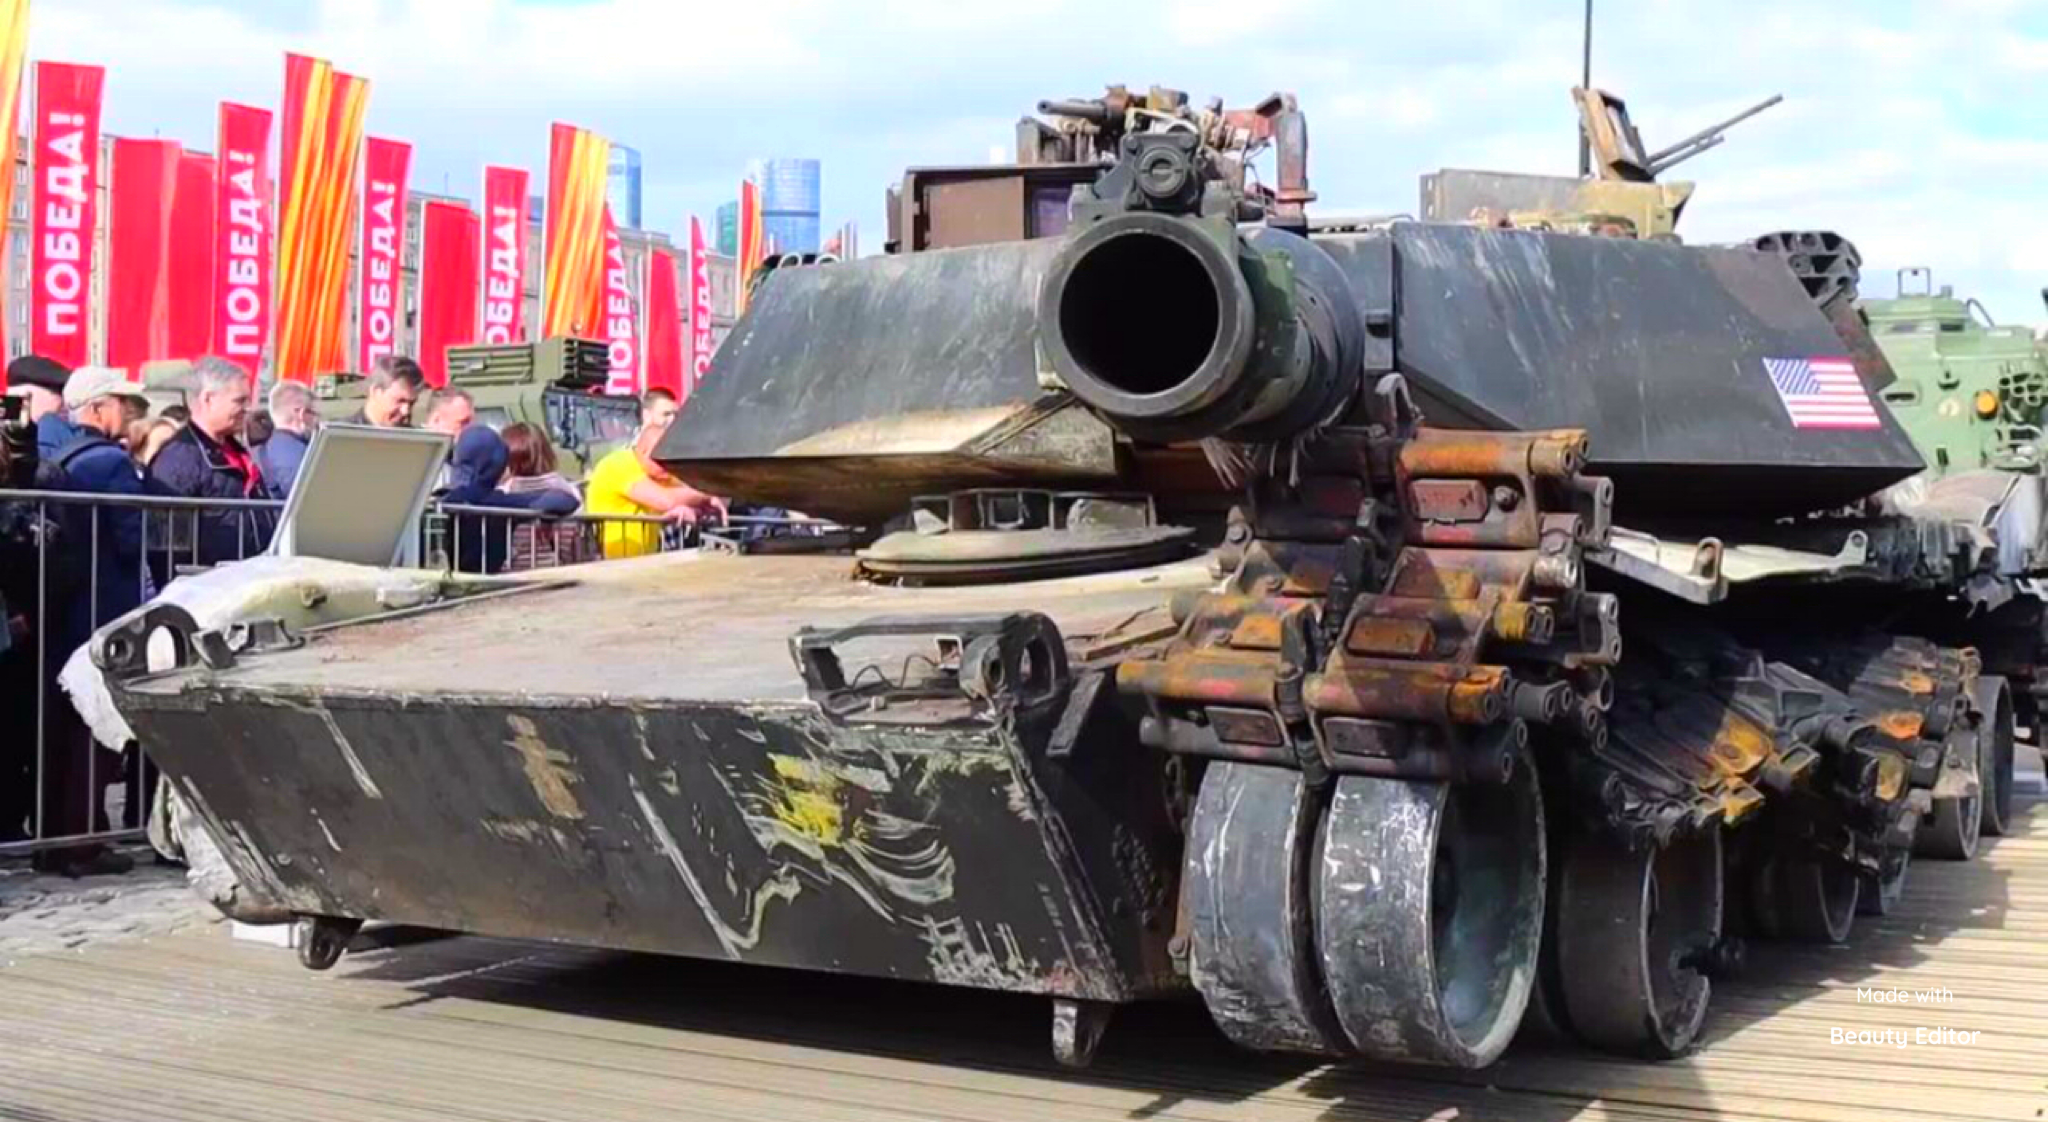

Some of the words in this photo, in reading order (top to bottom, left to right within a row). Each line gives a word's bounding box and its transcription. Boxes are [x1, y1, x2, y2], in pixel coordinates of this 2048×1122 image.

[45, 112, 87, 335] ПОБЕДА!
[226, 150, 264, 354] ПОБЕДА!
[486, 206, 520, 344] ОБЕДА!
